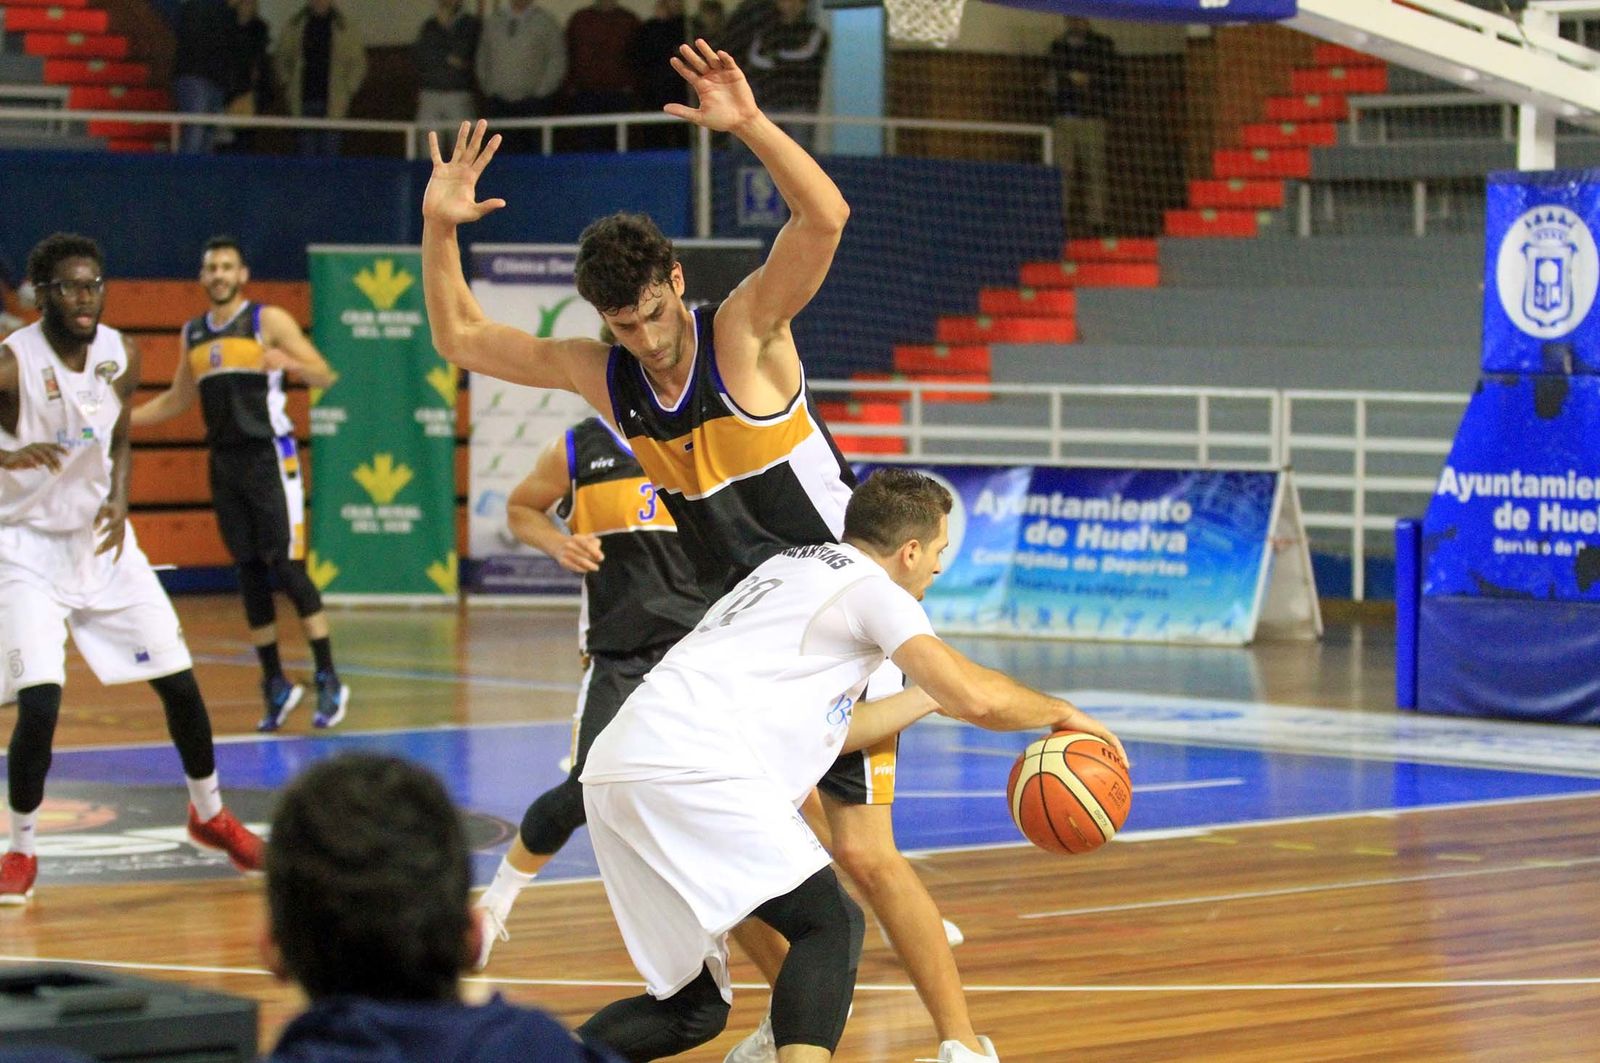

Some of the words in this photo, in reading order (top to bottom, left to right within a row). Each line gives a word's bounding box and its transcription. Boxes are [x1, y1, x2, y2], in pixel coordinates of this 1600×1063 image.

[638, 483, 656, 521] 3
[974, 490, 1192, 523] Ayuntamiento
[1494, 501, 1530, 531] de
[1024, 520, 1068, 547] de
[1075, 523, 1188, 553] Huelva
